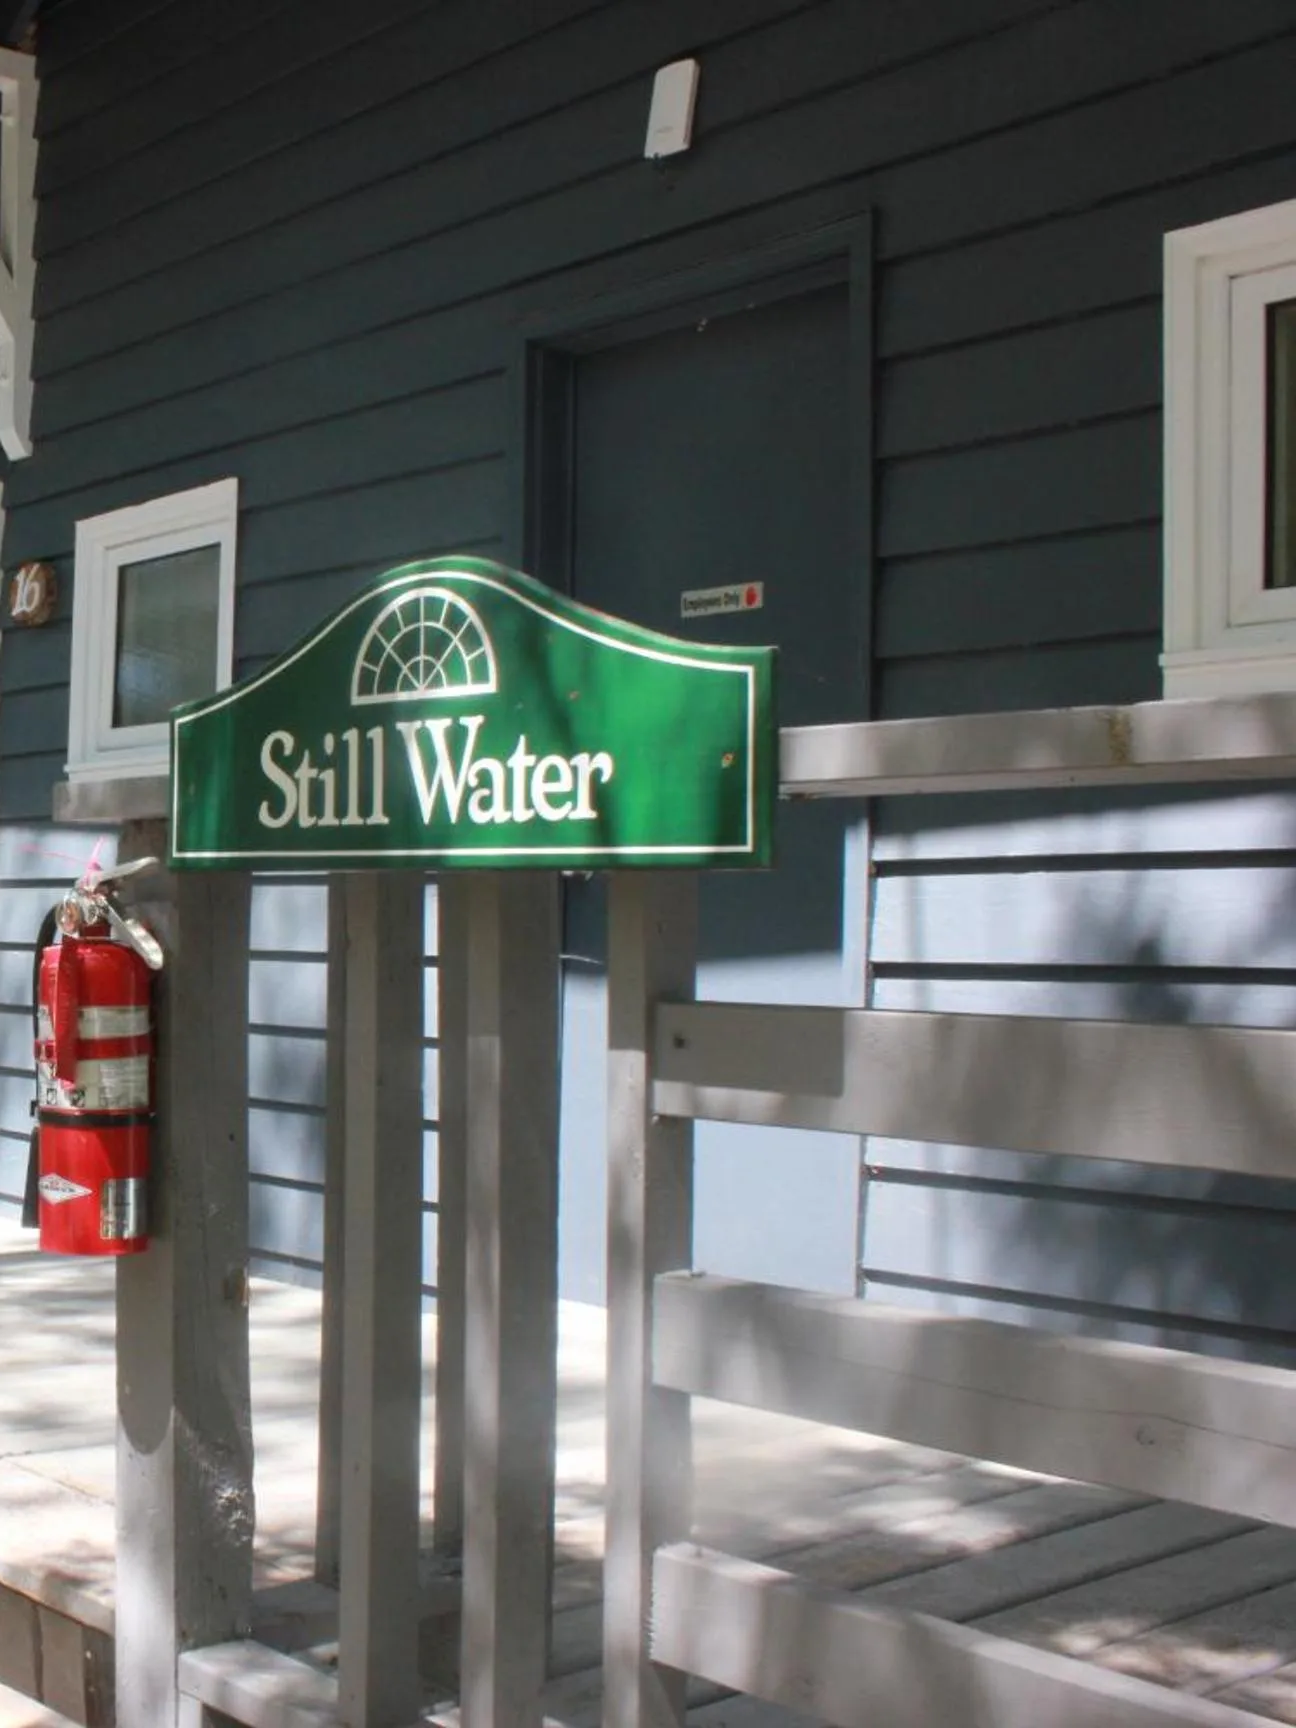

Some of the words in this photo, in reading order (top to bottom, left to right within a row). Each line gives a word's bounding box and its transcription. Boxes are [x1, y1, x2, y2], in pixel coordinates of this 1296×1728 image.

[11, 562, 40, 616] 16
[258, 726, 390, 829] Still
[396, 715, 613, 825] Water
